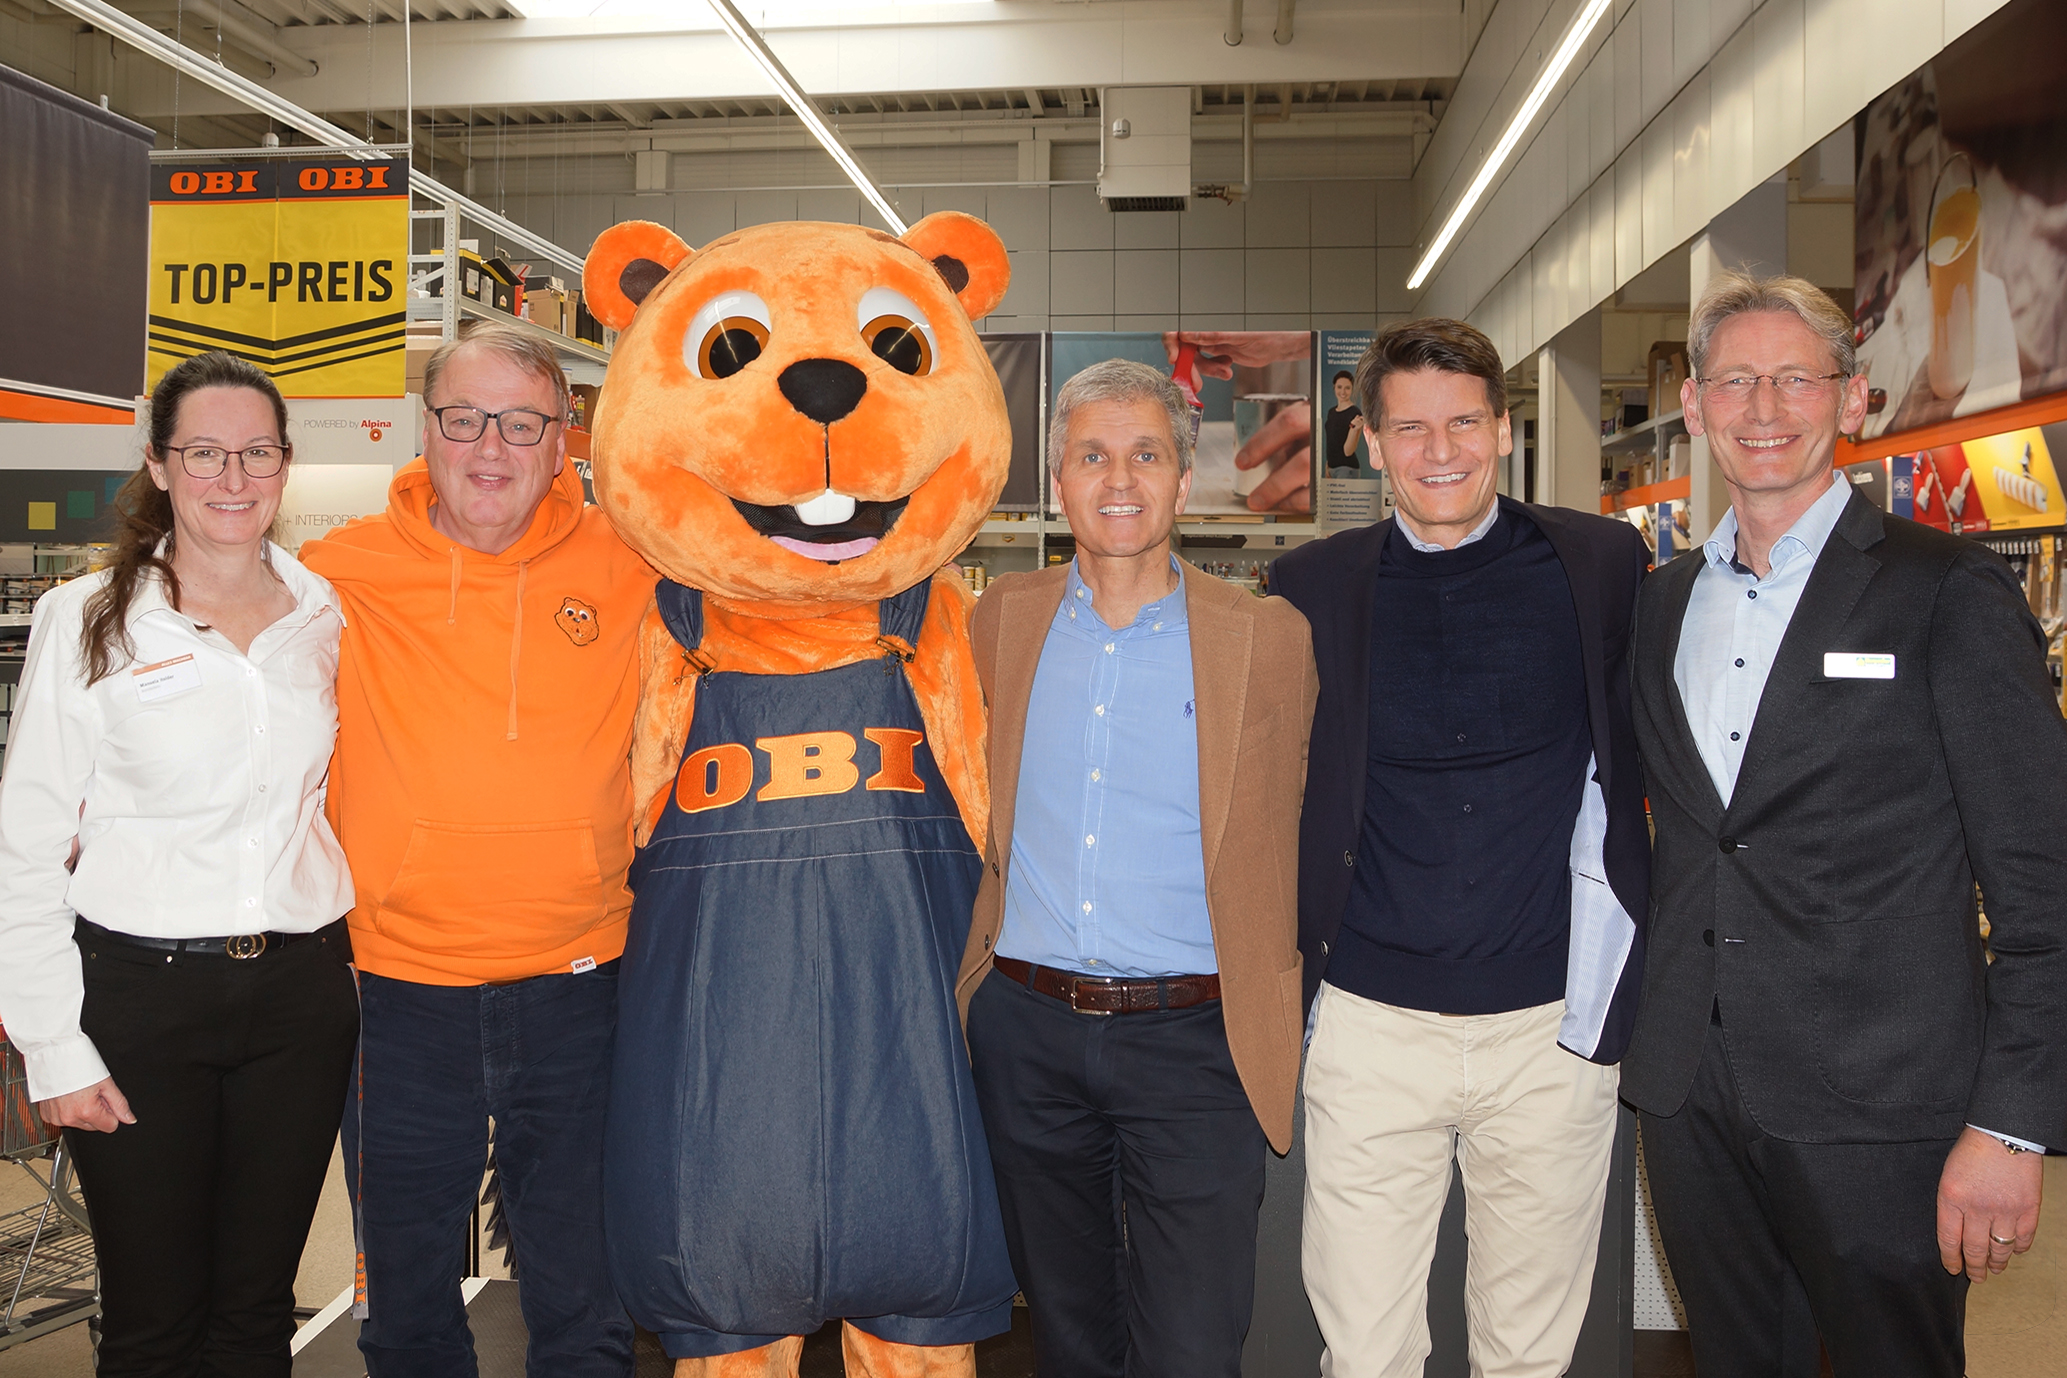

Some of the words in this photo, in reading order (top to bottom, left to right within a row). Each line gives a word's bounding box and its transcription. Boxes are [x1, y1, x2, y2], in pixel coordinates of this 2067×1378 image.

[169, 170, 259, 195] OBI
[298, 166, 390, 191] OBI
[164, 259, 393, 305] TOP-PREIS
[304, 419, 347, 428] POWERED
[349, 419, 359, 430] by
[360, 419, 392, 430] Alpina
[676, 727, 925, 814] OBI
[575, 959, 593, 969] OBI
[356, 1252, 367, 1304] OBI
